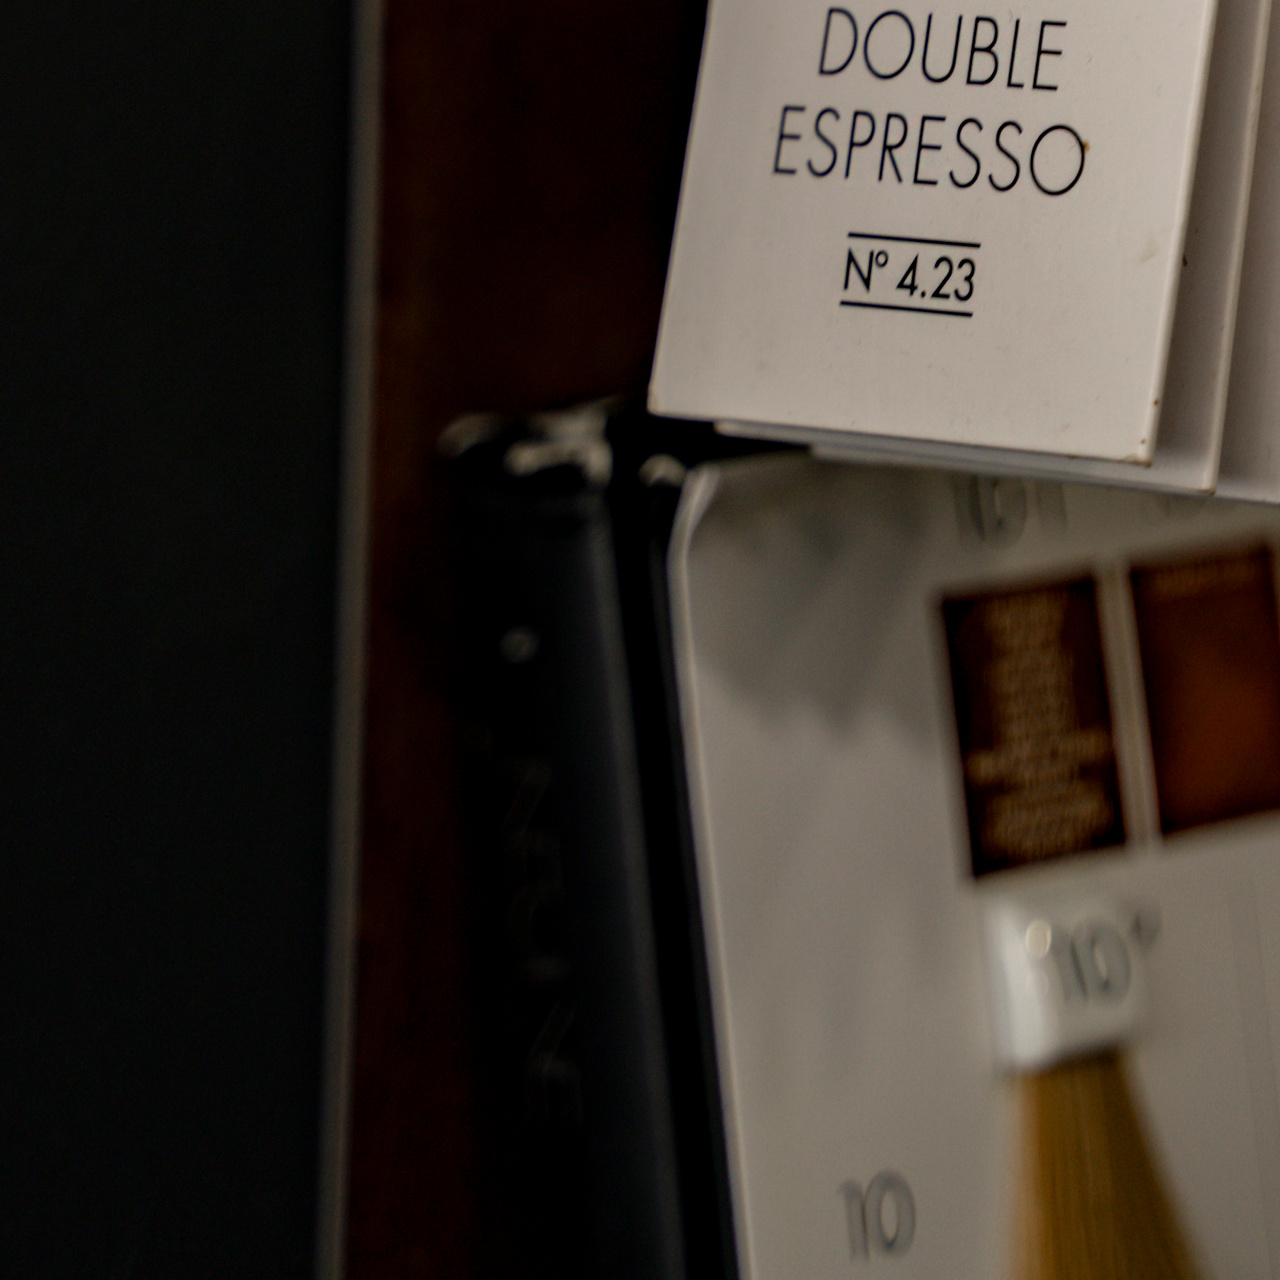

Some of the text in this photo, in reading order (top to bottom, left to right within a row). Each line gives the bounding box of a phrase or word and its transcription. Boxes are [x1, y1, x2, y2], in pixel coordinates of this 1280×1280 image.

[818, 7, 1067, 90] DOUBLE
[772, 106, 1086, 196] ESPRESSO
[896, 253, 976, 302] 4.23
[837, 1169, 916, 1261] 10
